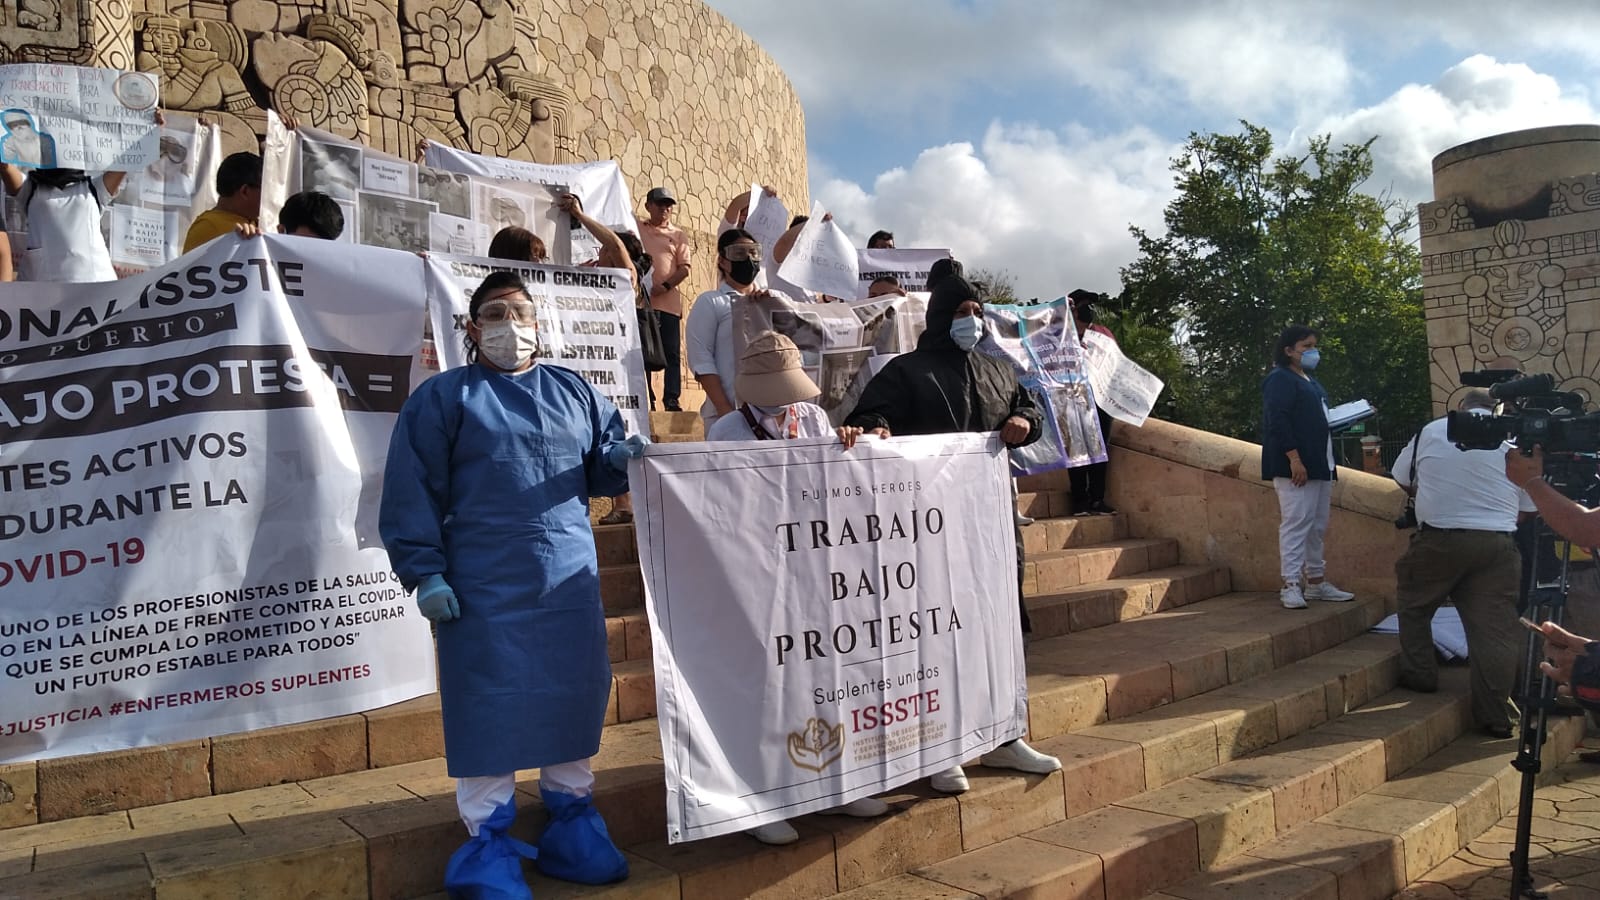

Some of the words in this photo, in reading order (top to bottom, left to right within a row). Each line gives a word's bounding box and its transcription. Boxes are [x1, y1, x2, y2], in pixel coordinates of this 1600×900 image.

[80, 84, 100, 98] PARA
[59, 133, 72, 145] EN
[77, 134, 88, 147] EL
[124, 234, 169, 246] PROTESTA
[139, 258, 304, 310] ISSSTE
[552, 270, 617, 290] GENERAL
[572, 320, 615, 337] ARCEO
[619, 322, 627, 337] Y
[561, 345, 618, 361] ESTATAL
[112, 359, 356, 416] PROTESA
[83, 432, 248, 481] ACTIVOS
[0, 482, 192, 541] DURANTE
[203, 478, 249, 508] LA
[801, 485, 863, 502] FUIMOS
[871, 480, 923, 496] HEROES
[775, 507, 944, 553] TRABAJO
[830, 560, 917, 602] BAJO
[1, 618, 50, 638] UNO
[56, 612, 84, 629] DE
[90, 605, 128, 624] LOS
[133, 582, 290, 618] PROFESIONISTAS
[295, 578, 319, 595] DE
[323, 576, 343, 591] LA
[346, 571, 387, 588] SALUD
[23, 637, 52, 654] EN
[59, 632, 86, 649] LA
[91, 624, 149, 645] LÍNEA
[154, 618, 179, 634] DE
[184, 607, 254, 629] FRENTE
[259, 597, 335, 619] CONTRA
[338, 593, 356, 608] EL
[5, 658, 53, 680] QUE
[59, 654, 84, 670] SE
[89, 641, 171, 665] CUMPLA
[176, 635, 199, 651] LO
[204, 619, 316, 647] PROMETIDO
[319, 617, 330, 629] Y
[334, 605, 406, 628] ASEGURAR
[774, 604, 963, 667] PROTESTA
[34, 678, 66, 696] UN
[72, 663, 151, 690] FUTURO
[156, 651, 239, 674] ESTABLE
[242, 642, 295, 662] PARA
[108, 680, 266, 717] #ENFERMEROS
[270, 663, 372, 693] SUPLENTES
[812, 677, 893, 706] Suplentes
[897, 664, 940, 686] unidos
[851, 689, 941, 733] ISSSTE
[852, 733, 889, 748] INSTITUTO
[890, 729, 901, 738] DE
[854, 742, 908, 763] TRABAJADORES
[908, 738, 919, 748] DEL
[859, 739, 898, 754] SERVICIOS
[898, 730, 926, 744] SOCIALES
[936, 722, 948, 732] LOS
